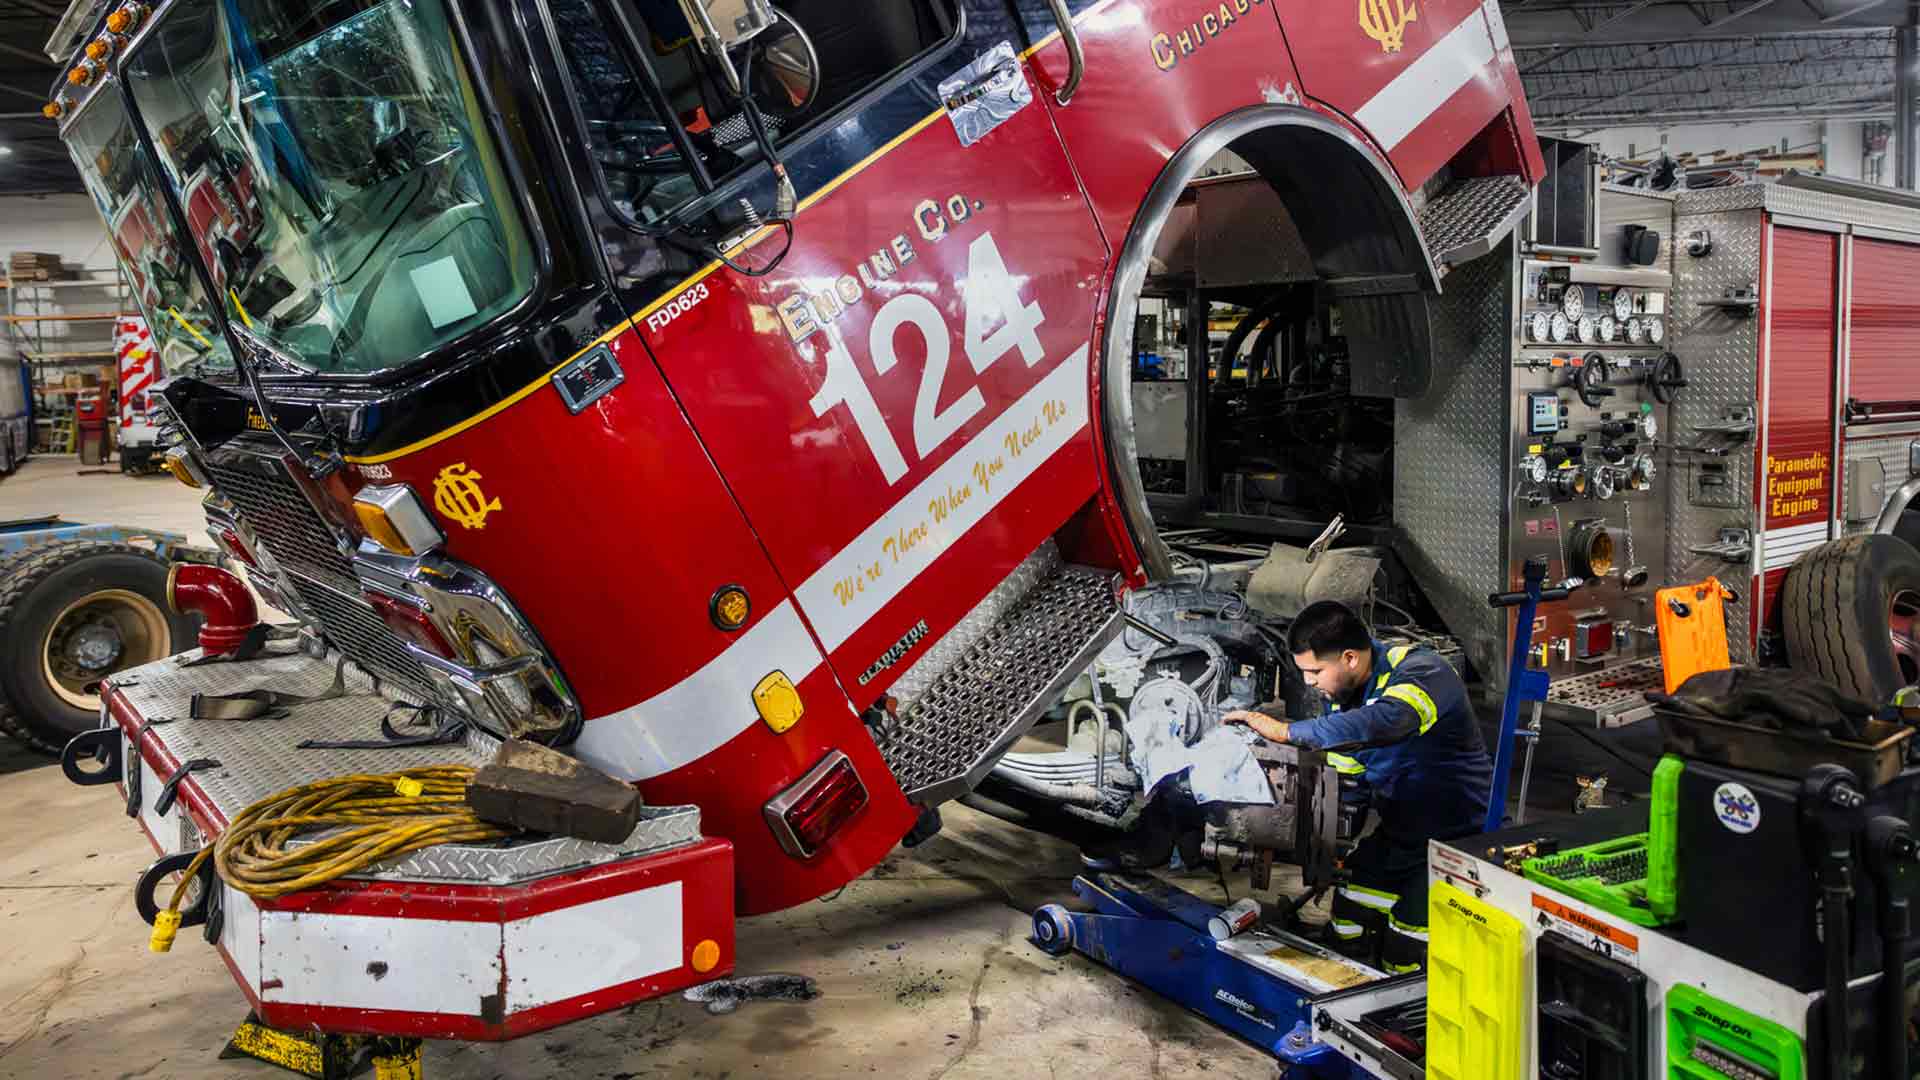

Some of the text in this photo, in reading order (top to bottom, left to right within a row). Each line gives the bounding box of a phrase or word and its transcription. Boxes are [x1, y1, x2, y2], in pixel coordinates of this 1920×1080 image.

[1151, 0, 1264, 71] CHICAG
[776, 193, 985, 344] ENGINE CO.
[646, 282, 710, 334] FDD623
[808, 230, 1046, 487] 124
[1767, 451, 1827, 474] Paramedic
[1768, 471, 1823, 498] Equipped
[832, 399, 1067, 607] We're There When You Need Us
[1772, 495, 1819, 518] Engine
[858, 618, 929, 686] GLADIATOR
[1568, 911, 1611, 938] WARNING
[1692, 1004, 1753, 1040] Snap-on
